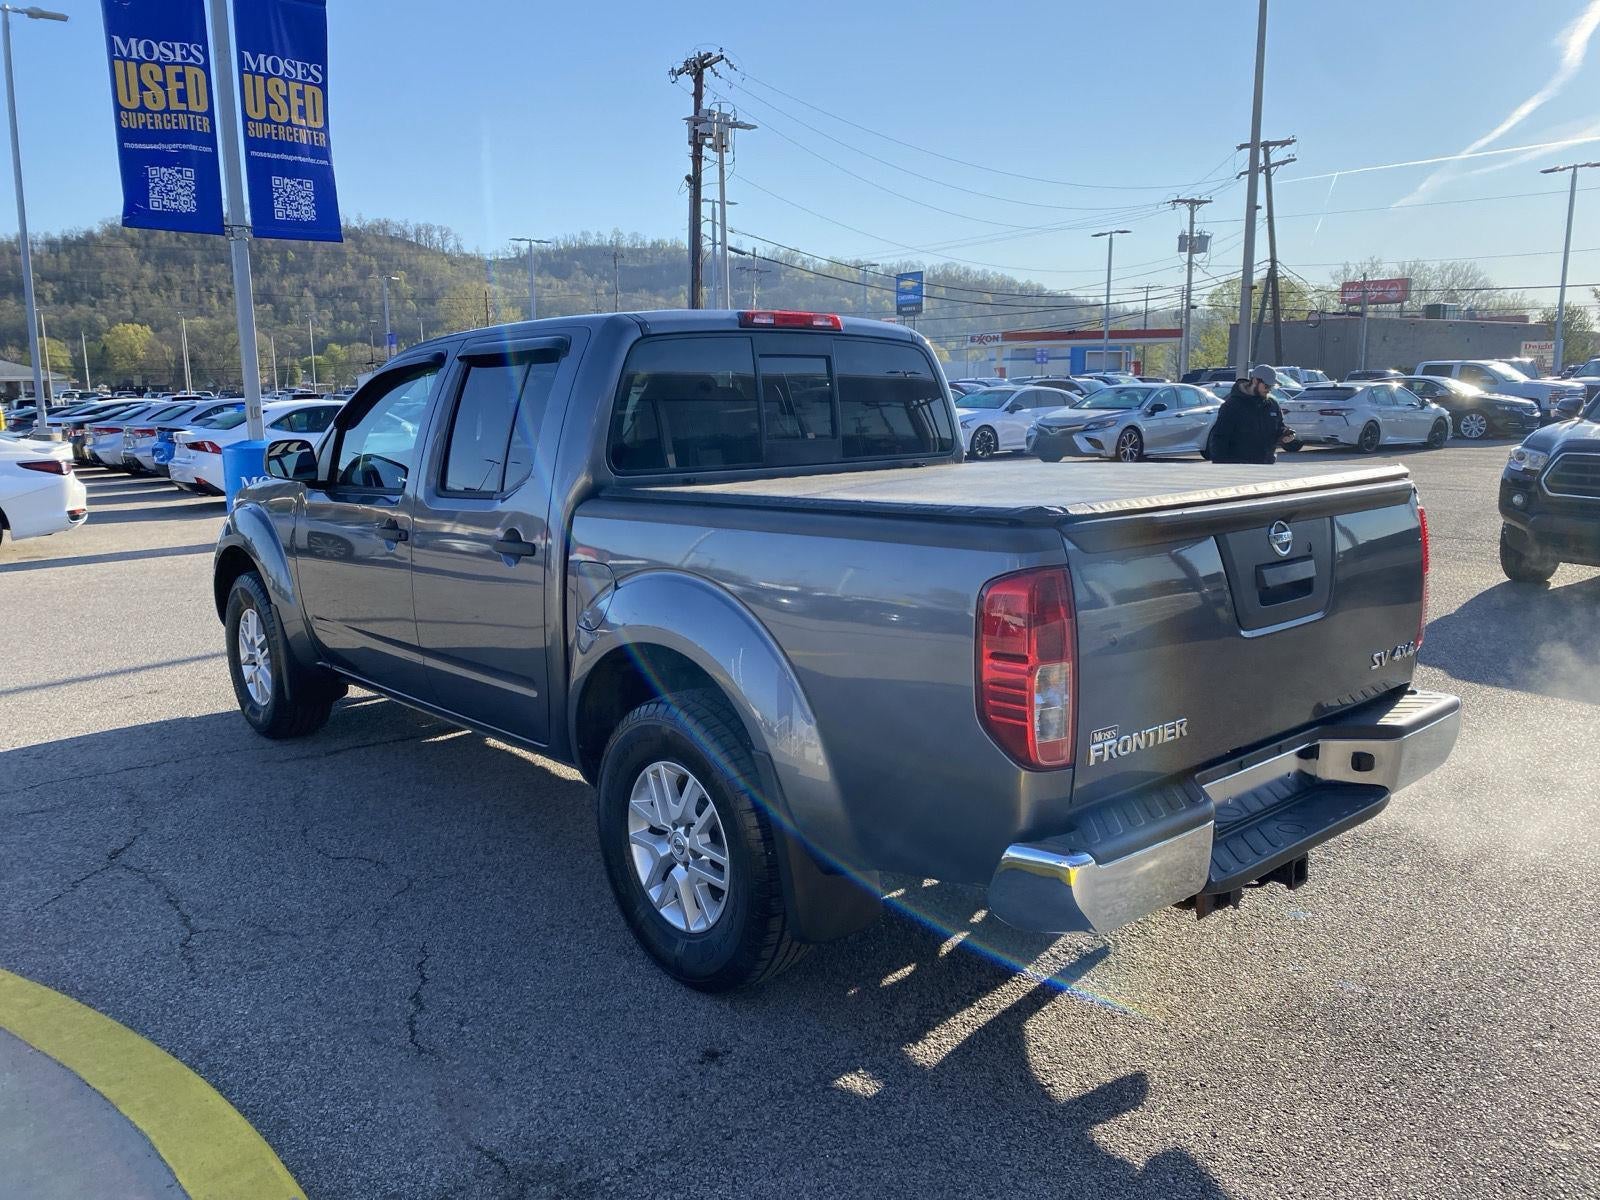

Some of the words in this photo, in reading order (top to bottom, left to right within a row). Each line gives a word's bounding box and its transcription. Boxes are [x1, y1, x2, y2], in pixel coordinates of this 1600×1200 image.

[111, 35, 205, 65] MOSES
[242, 50, 323, 84] MOSES
[113, 60, 209, 113] USED
[243, 73, 324, 129] USED
[120, 110, 211, 134] SUPERCENTER
[247, 121, 326, 147] SUPERCENTER
[123, 142, 213, 153] mosesusedsupercenter.com
[250, 150, 329, 166] mosesusedsupercenter.com
[970, 333, 1000, 345] EXXON
[1370, 649, 1390, 670] SV
[1087, 718, 1188, 767] FRONTIER
